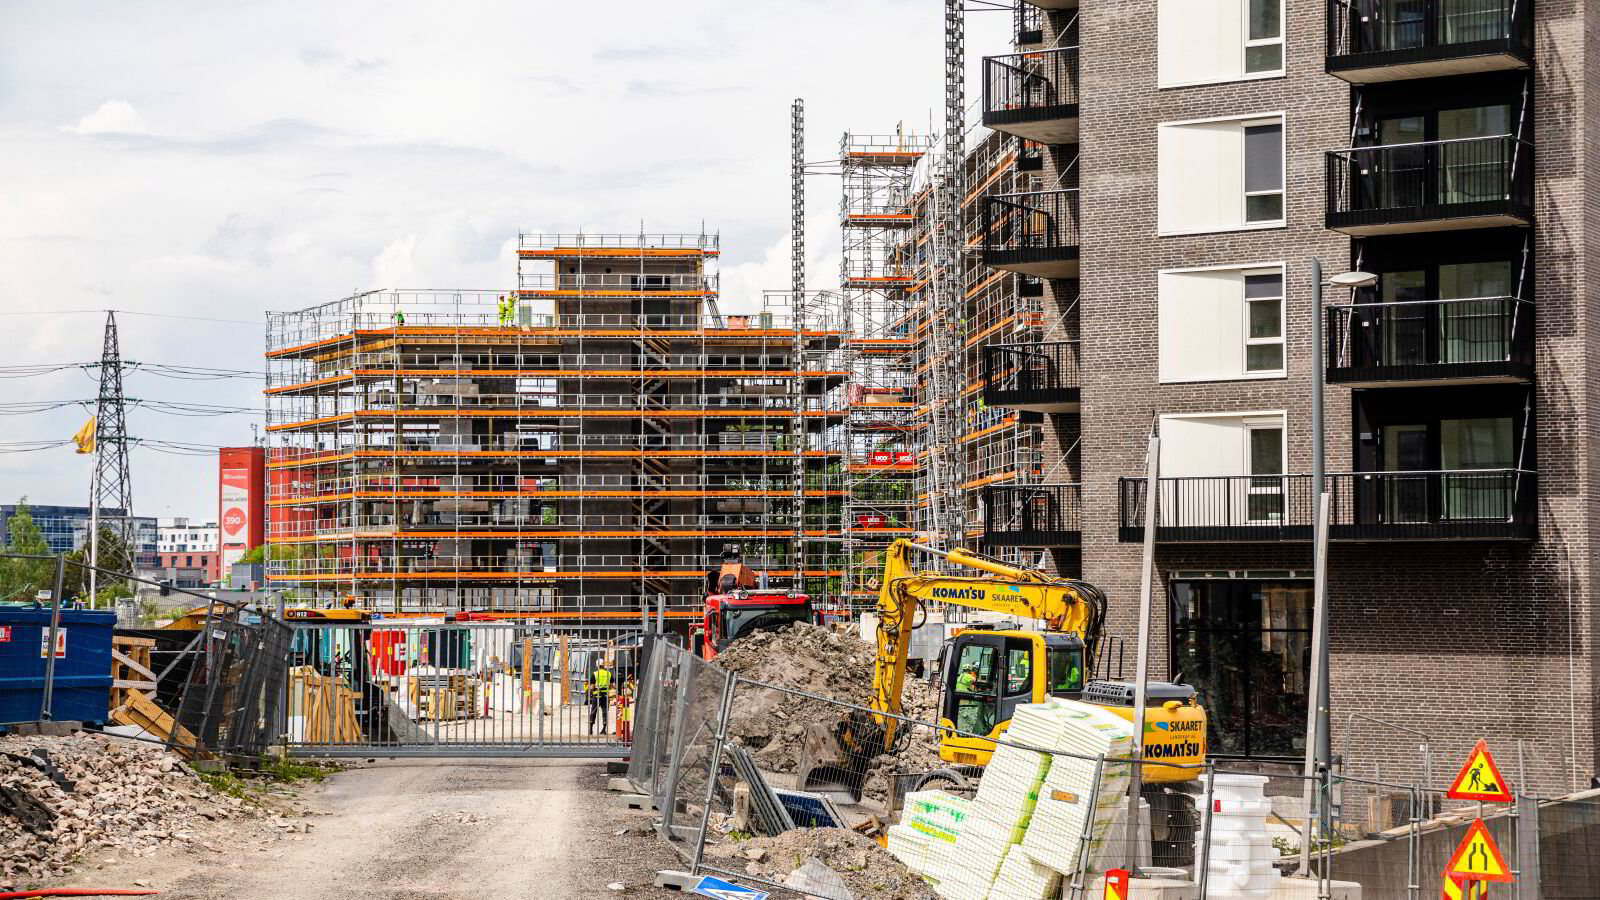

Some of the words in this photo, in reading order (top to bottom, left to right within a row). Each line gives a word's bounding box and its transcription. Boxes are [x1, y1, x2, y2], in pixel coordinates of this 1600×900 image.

[225, 516, 241, 525] 390
[932, 587, 985, 600] KOMATSU
[992, 593, 1022, 603] SKAARET
[1170, 720, 1202, 732] SKAARET
[1145, 740, 1200, 758] KOMATSU
